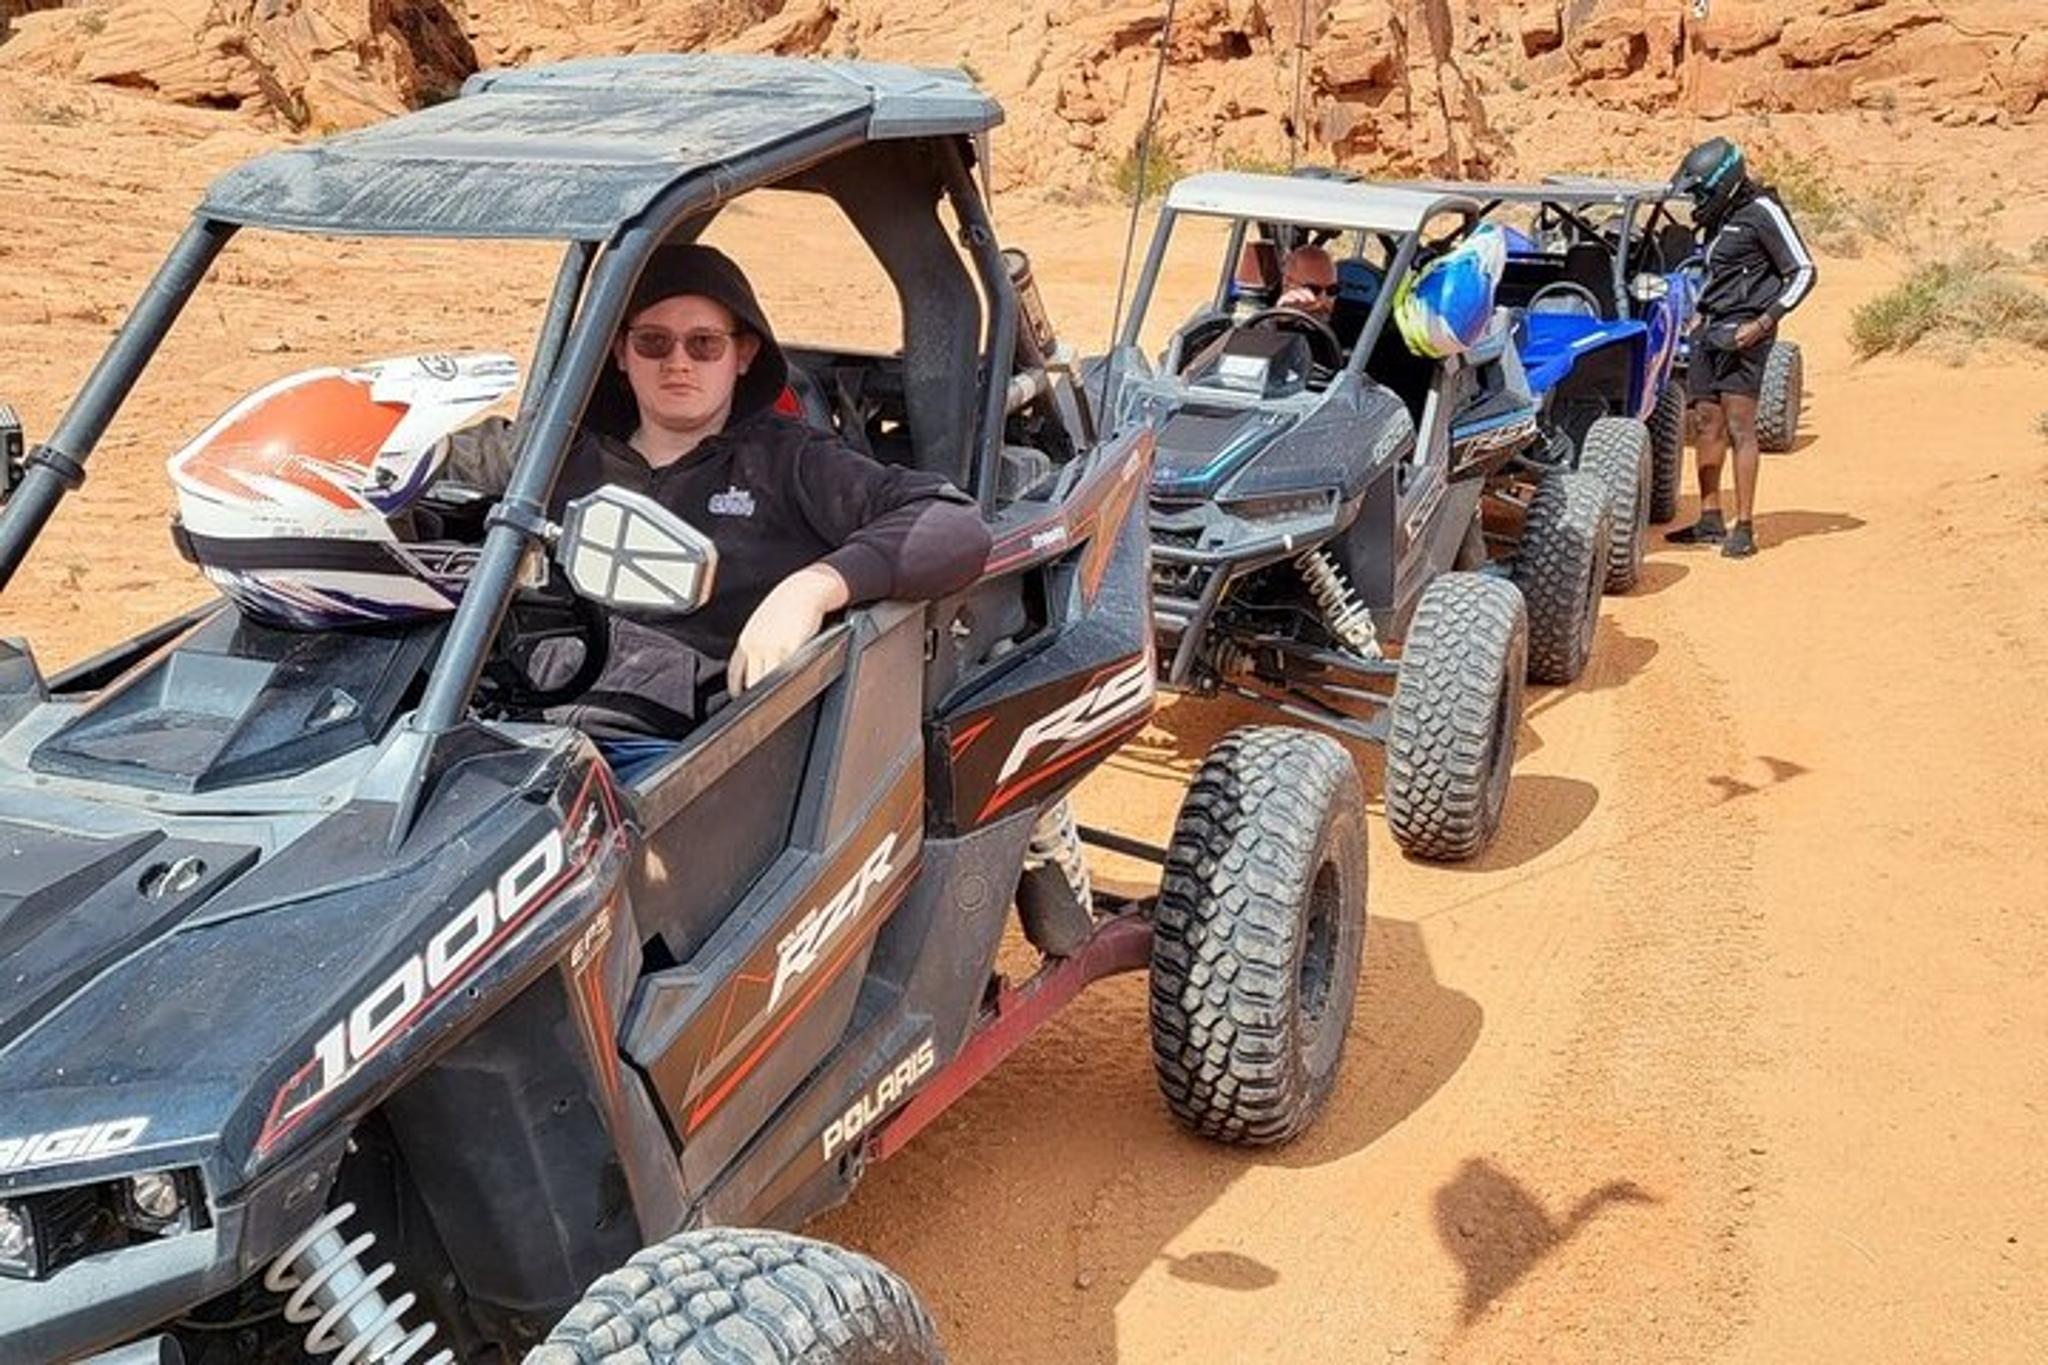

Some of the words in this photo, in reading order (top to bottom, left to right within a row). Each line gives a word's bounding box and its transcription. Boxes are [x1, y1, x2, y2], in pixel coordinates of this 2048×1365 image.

[315, 828, 564, 1087] 1000
[767, 832, 897, 1012] RZR
[823, 1038, 936, 1161] POLARIS
